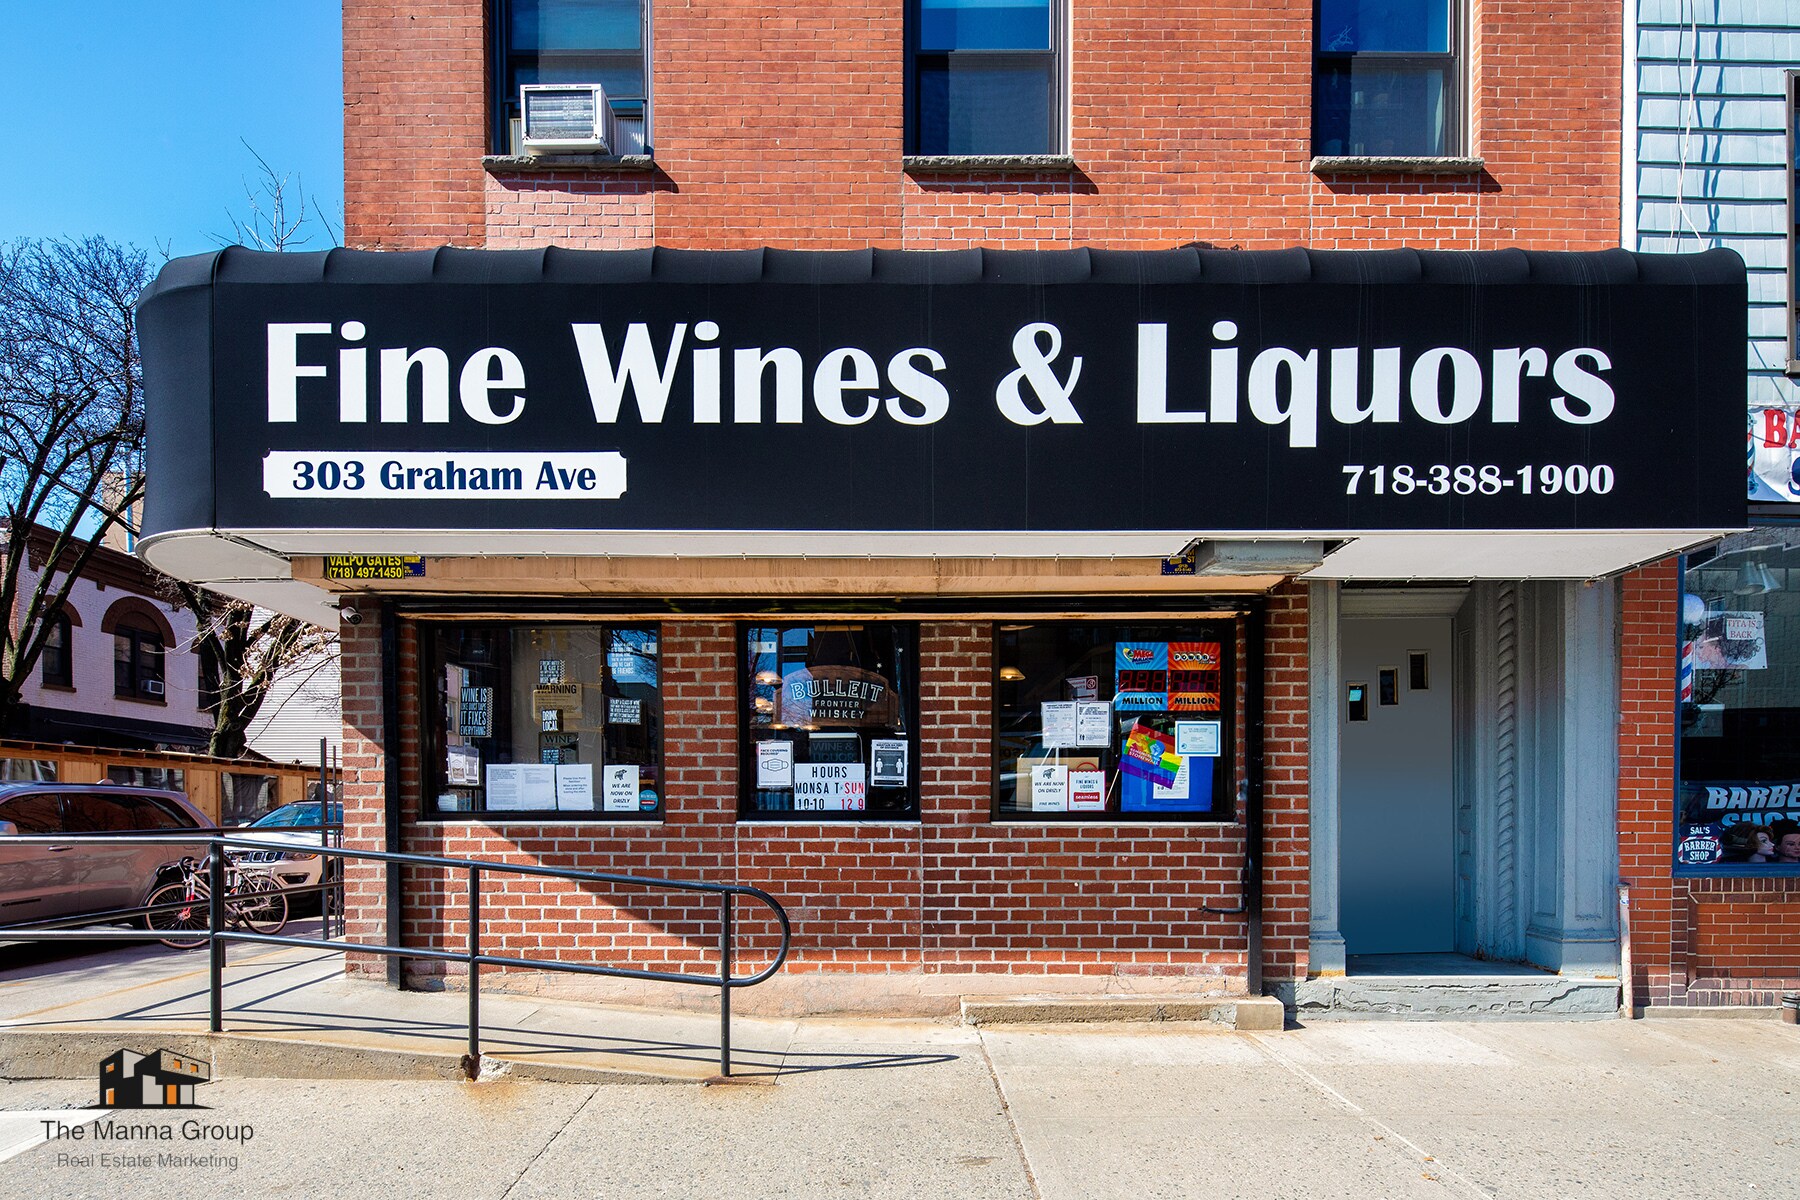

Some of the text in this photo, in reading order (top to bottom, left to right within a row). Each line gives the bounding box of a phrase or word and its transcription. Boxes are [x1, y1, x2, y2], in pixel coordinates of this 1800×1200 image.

[267, 320, 1616, 448] Fine Wines & Liquors
[292, 460, 597, 491] 303 Graham Ave
[1342, 464, 1615, 495] 718-388-1900
[329, 555, 401, 567] VALPO GATES
[329, 566, 354, 579] (718)
[356, 567, 402, 578] 497-1450
[1729, 630, 1753, 639] BACK
[536, 684, 577, 694] WARNING
[790, 679, 884, 703] BULLEIT
[461, 687, 487, 703] WINE IS
[814, 700, 860, 708] FRONTIER
[1122, 697, 1163, 705] MILLION
[1174, 697, 1216, 705] MILLION
[460, 711, 487, 726] IT FIXES
[542, 709, 558, 720] DRINK
[809, 709, 865, 719] WHISKEY
[460, 725, 487, 736] EVERYTHING
[542, 721, 559, 732] LOCAL
[812, 742, 855, 751] WINE &
[813, 752, 855, 761] LIQUOR
[812, 766, 848, 778] HOURS
[797, 798, 864, 810] 10-10 12 9
[1689, 826, 1711, 835] SAL'S
[1684, 840, 1716, 851] BARBER
[1689, 851, 1710, 860] SHOP
